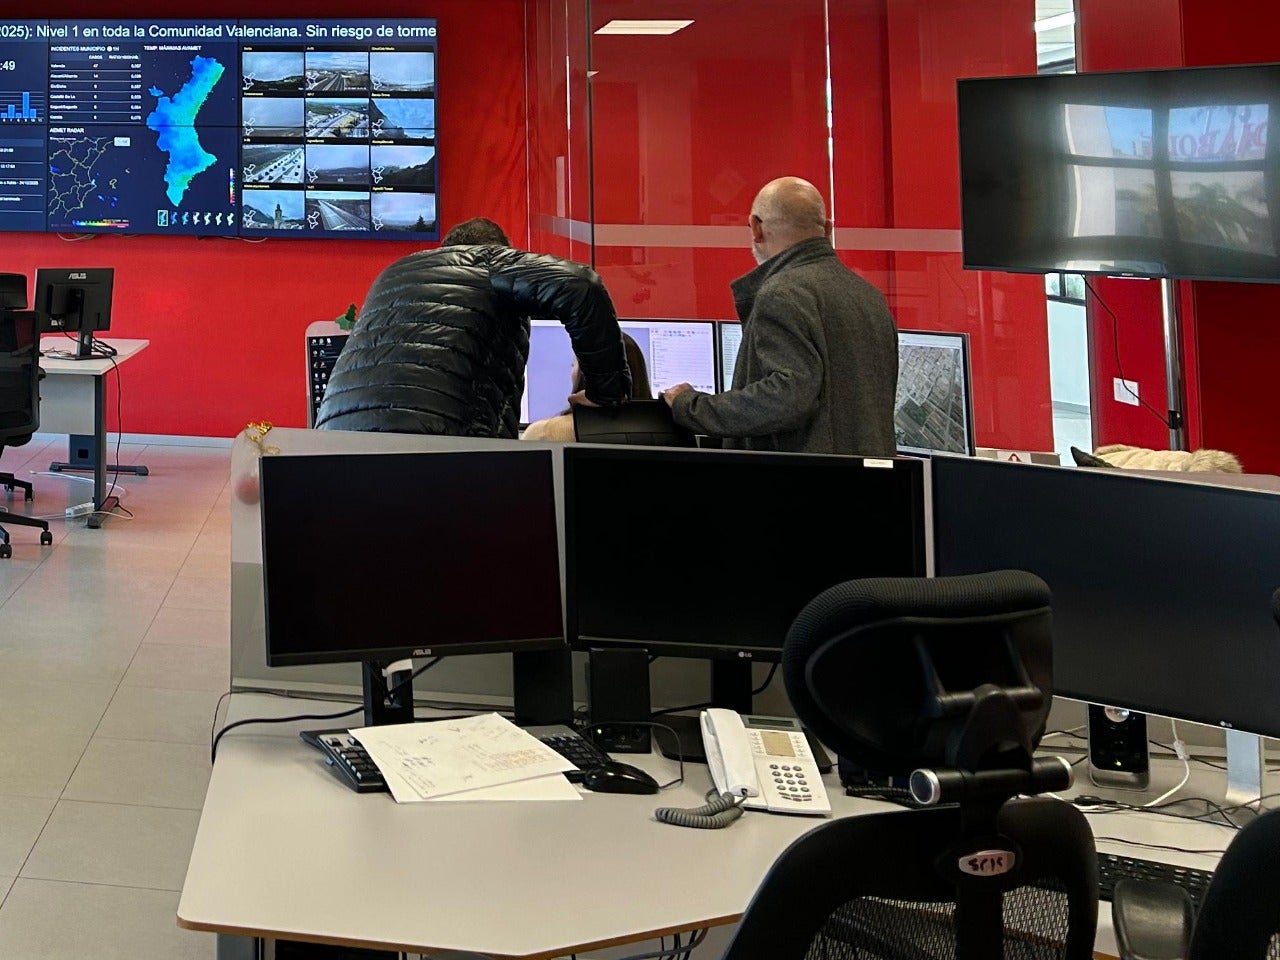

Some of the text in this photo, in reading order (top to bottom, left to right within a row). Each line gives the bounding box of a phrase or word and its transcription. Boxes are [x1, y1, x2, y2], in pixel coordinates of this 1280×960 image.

[36, 25, 68, 38] Nivel
[72, 26, 79, 38] 1
[83, 28, 99, 38] en
[102, 25, 130, 38] toda
[134, 25, 145, 38] la
[148, 25, 222, 38] Comunidad
[225, 25, 302, 38] Valenciana.
[306, 25, 328, 38] Sin
[332, 25, 373, 40] riesgo
[376, 25, 394, 38] de
[397, 25, 437, 38] torme
